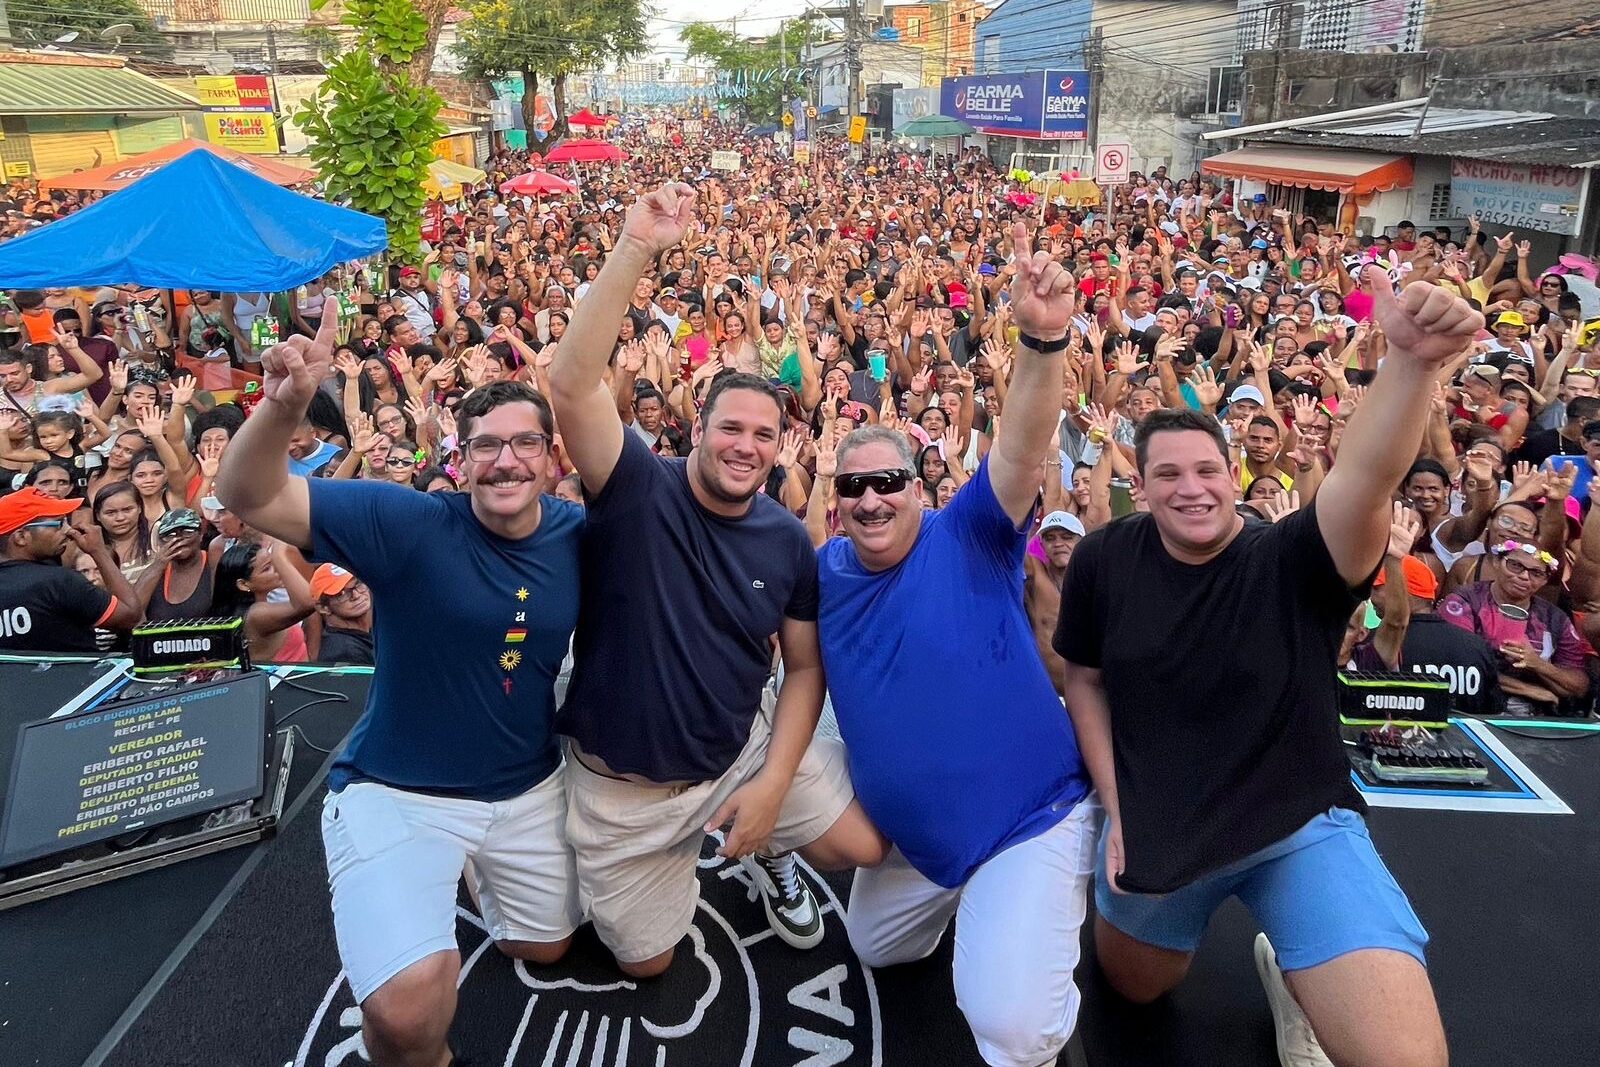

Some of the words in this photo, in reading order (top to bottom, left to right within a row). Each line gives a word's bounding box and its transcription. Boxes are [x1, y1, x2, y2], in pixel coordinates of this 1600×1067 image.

[208, 89, 237, 98] FARMA
[238, 89, 262, 98] VIDA
[967, 85, 1024, 98] FARMA
[1047, 96, 1086, 105] FARMA
[966, 98, 1011, 111] BELLE
[1047, 103, 1080, 112] BELLE
[220, 128, 264, 136] PRESENTES
[0, 606, 32, 638] IO
[153, 638, 211, 654] CUIDADO
[1412, 664, 1481, 696] OIO
[64, 717, 101, 730] BLOCO
[103, 702, 160, 722] BUCHUDOS
[162, 698, 177, 708] DO
[180, 687, 230, 704] CORDEIRO
[1366, 694, 1425, 710] CUIDADO
[114, 717, 136, 728] RUA
[138, 713, 151, 722] DA
[154, 706, 183, 718] LAMA
[114, 721, 155, 738] RECIFE
[166, 714, 180, 726] PE
[108, 730, 183, 755] VEREADOR
[83, 750, 152, 775] ERIBERTO
[156, 736, 208, 754] RAFAEL
[79, 763, 142, 787] DEPUTADO
[145, 749, 205, 770] ESTADUAL
[82, 772, 154, 798] ERIBERTO
[157, 760, 199, 779] FILHO
[76, 799, 137, 822] ERIBERTO
[140, 782, 200, 805] MEDEIROS
[80, 787, 144, 810] DEPUTADO
[147, 772, 200, 792] FEDERAL
[57, 814, 118, 838] PREFEITO
[130, 802, 163, 818] JOÃO
[166, 788, 215, 808] CAMPOS
